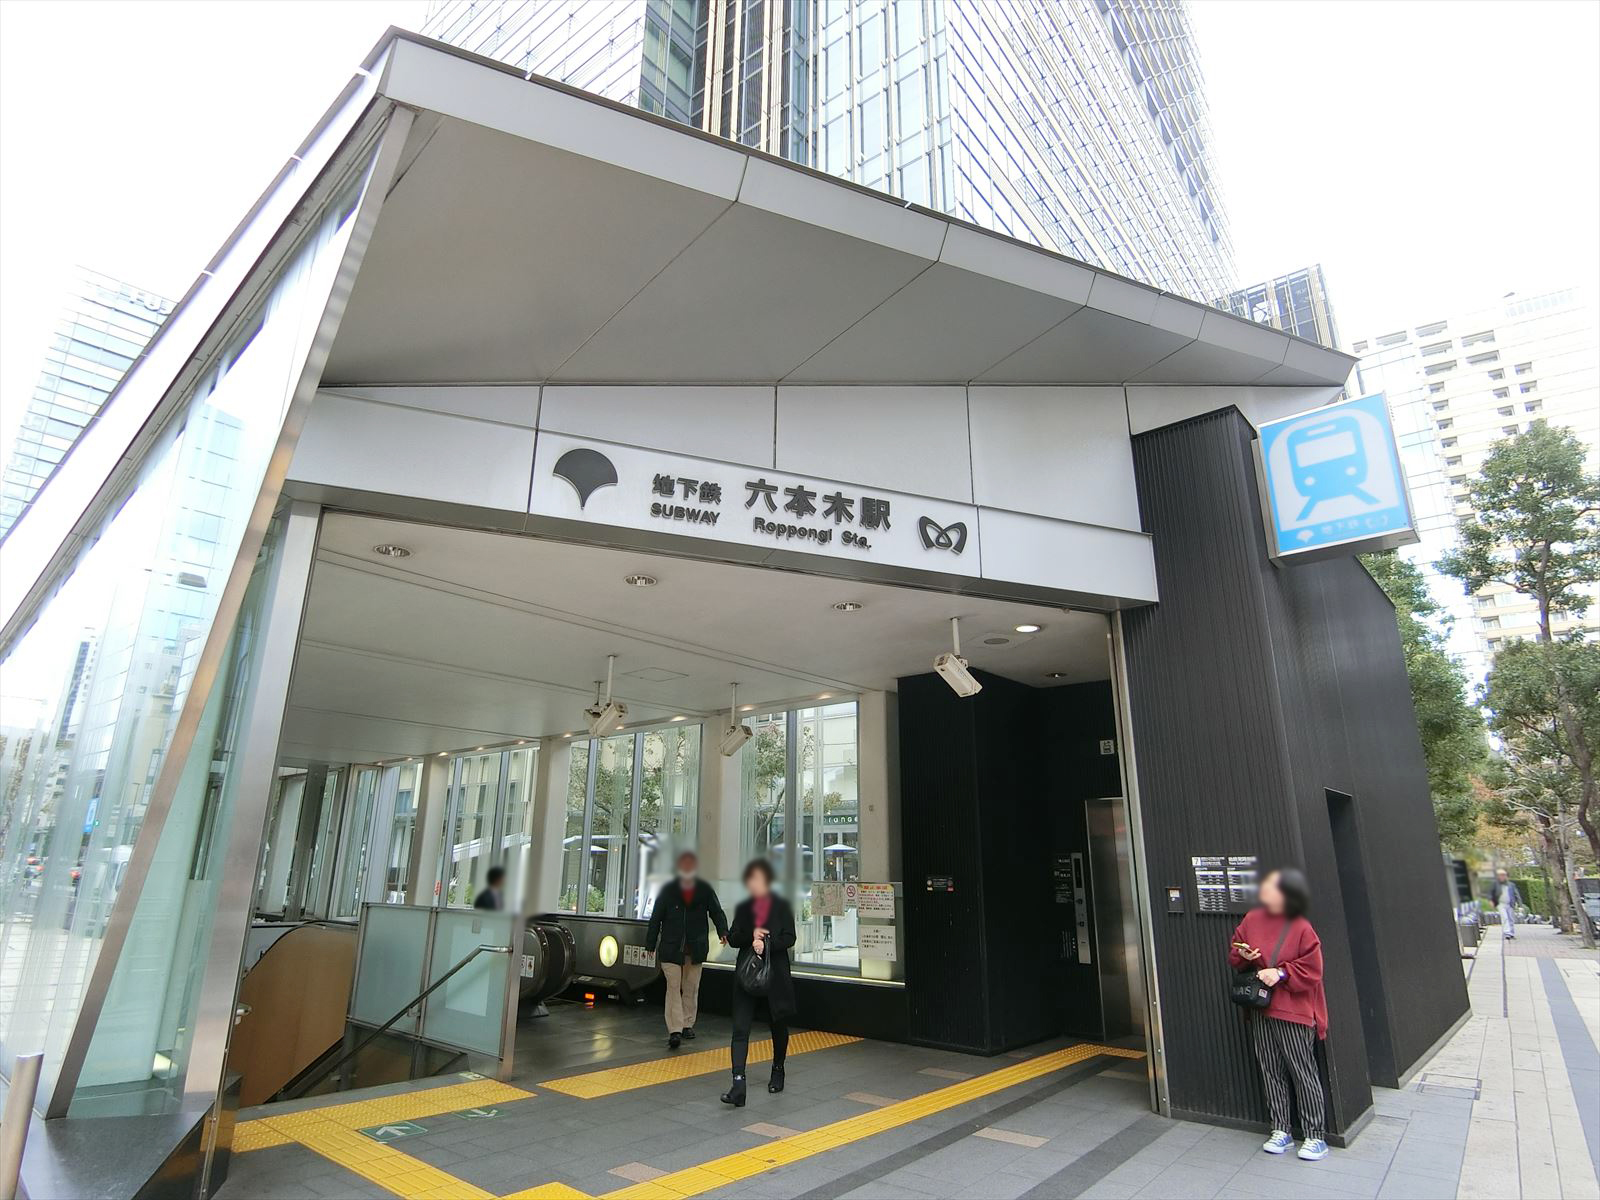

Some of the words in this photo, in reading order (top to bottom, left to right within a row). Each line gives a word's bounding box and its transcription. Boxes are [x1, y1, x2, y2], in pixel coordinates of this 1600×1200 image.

[650, 502, 720, 526] SUBWAY
[753, 516, 832, 545] Roppongi
[841, 530, 872, 552] Sta.
[652, 473, 721, 504] 地下鉄
[744, 478, 891, 531] 六本木駅
